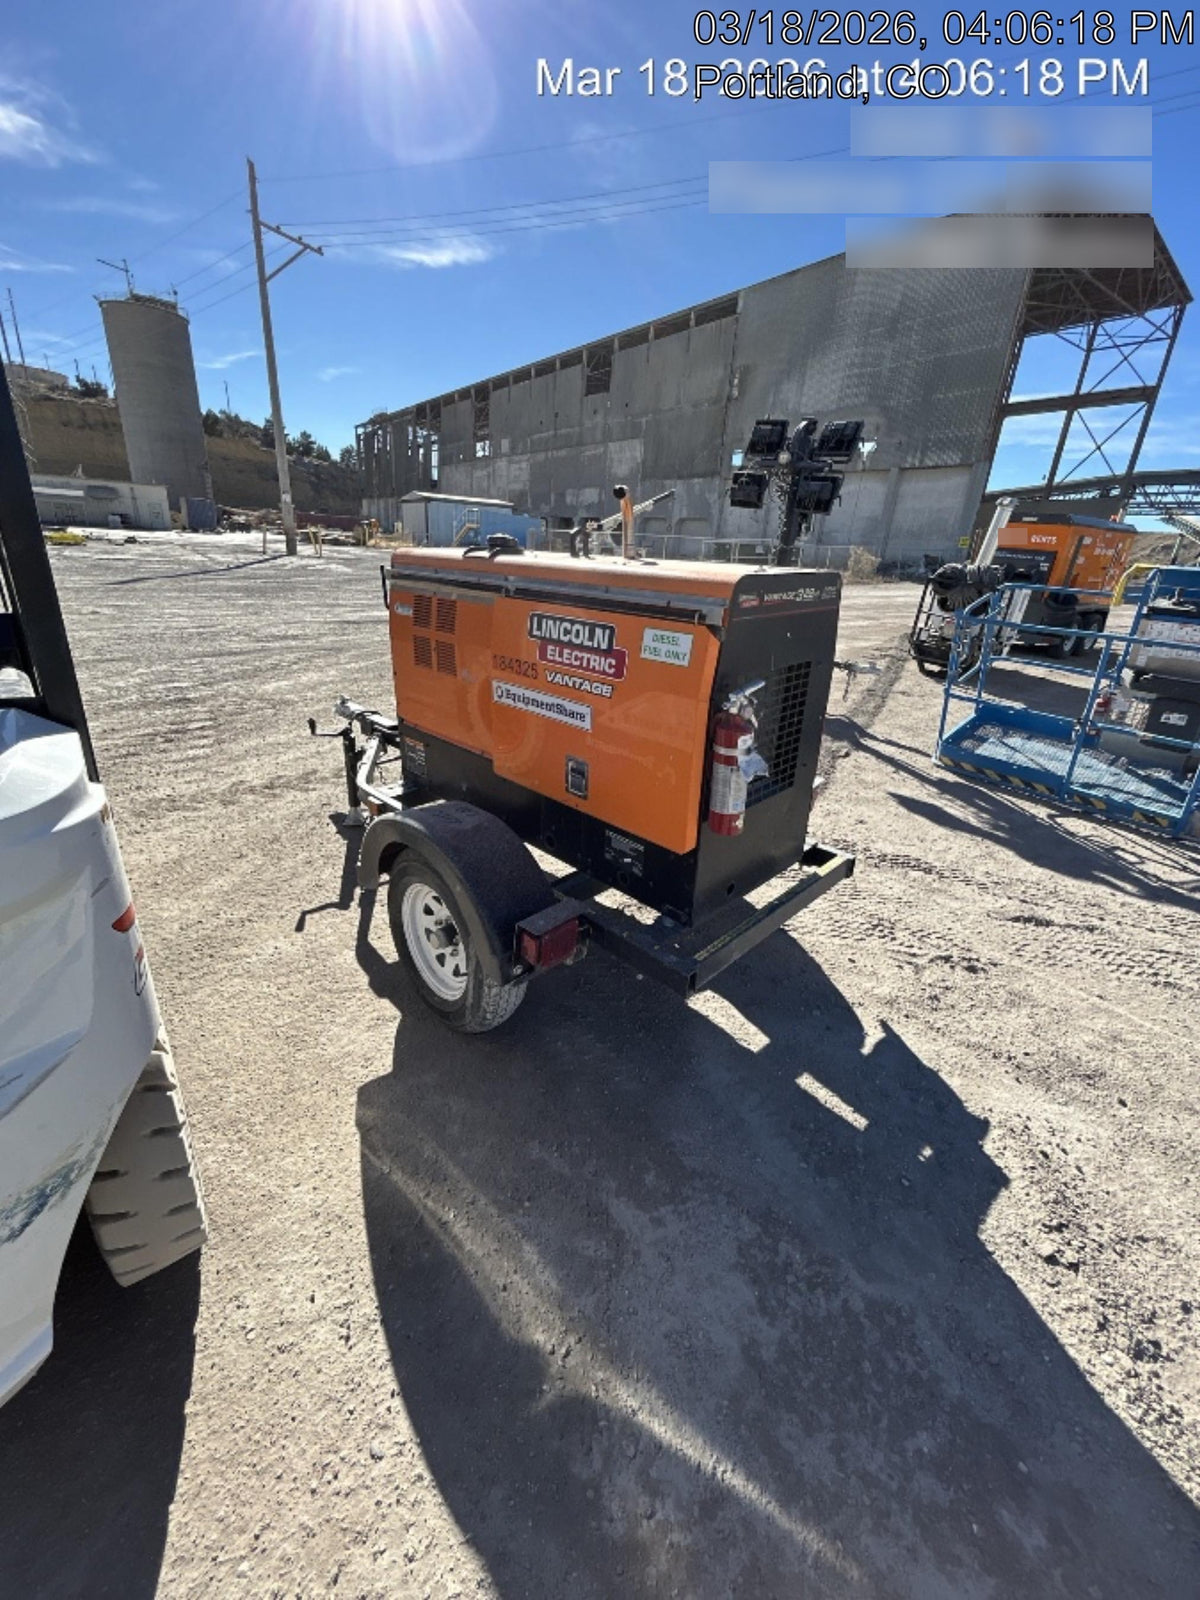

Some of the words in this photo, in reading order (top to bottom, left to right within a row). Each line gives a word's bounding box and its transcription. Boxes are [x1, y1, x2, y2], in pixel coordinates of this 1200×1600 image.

[531, 616, 611, 651] LINCOLN
[651, 632, 681, 648] DIESEL
[492, 653, 540, 681] 184325
[546, 644, 617, 675] ELECTRIC
[643, 646, 662, 659] FUEL
[664, 648, 688, 662] ONLY
[544, 669, 614, 699] VANTAGE
[503, 688, 587, 724] EquipmentShare
